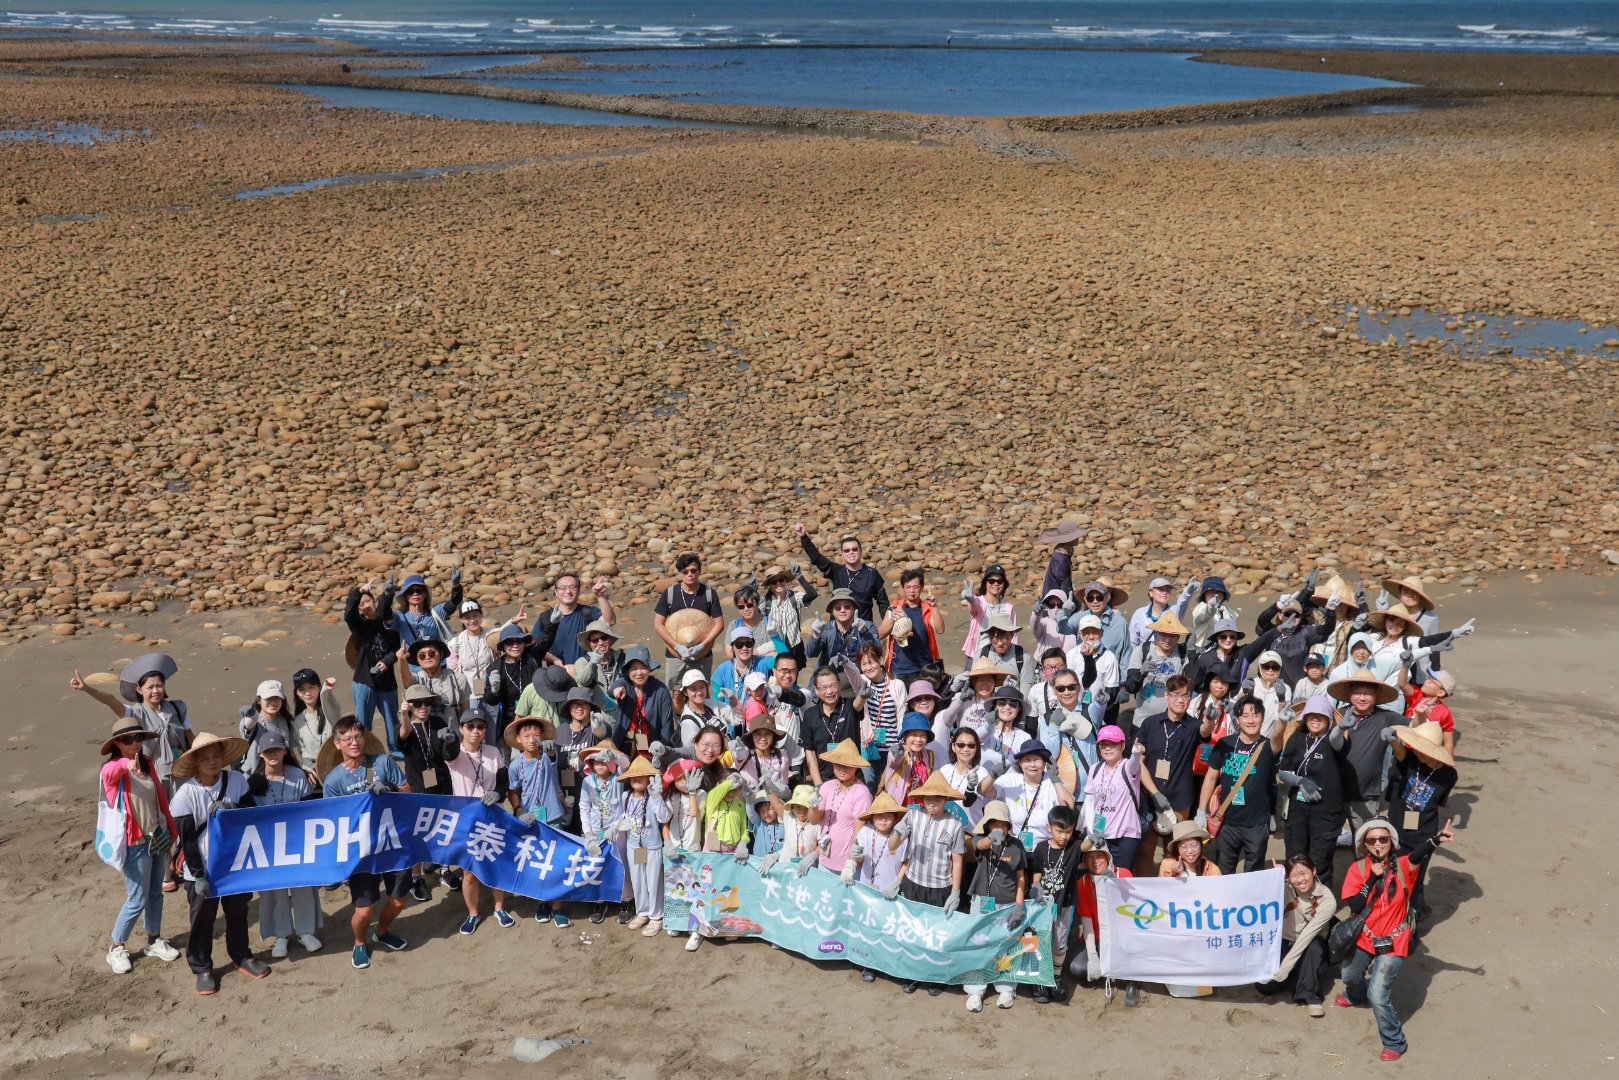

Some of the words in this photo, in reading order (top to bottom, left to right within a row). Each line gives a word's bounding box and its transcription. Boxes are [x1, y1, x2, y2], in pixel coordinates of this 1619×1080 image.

[230, 807, 402, 872] ALPHA
[413, 806, 605, 888] 明泰科技
[1168, 900, 1280, 930] hitron
